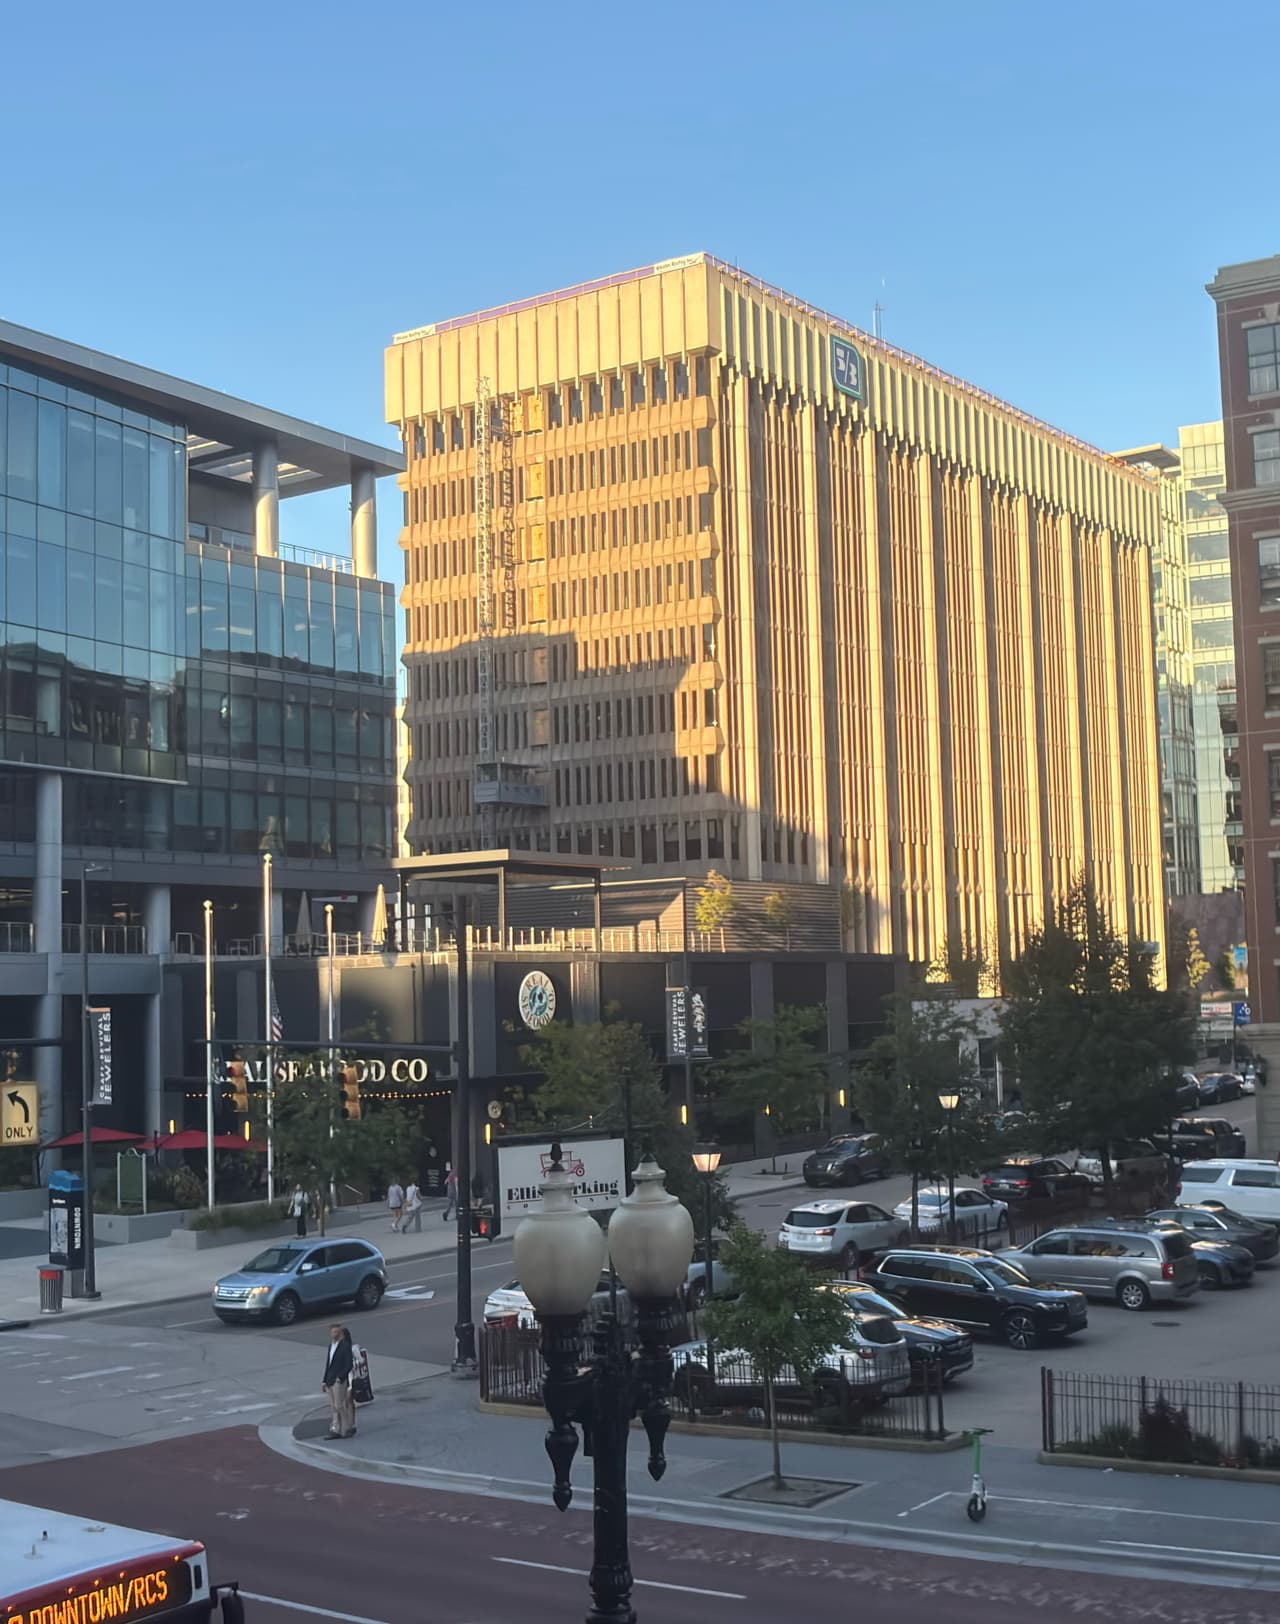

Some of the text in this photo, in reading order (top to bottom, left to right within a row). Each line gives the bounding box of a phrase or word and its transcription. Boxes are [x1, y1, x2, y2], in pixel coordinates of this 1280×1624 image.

[677, 991, 687, 1054] JEWELERS
[102, 1012, 112, 1101] JEWELERS
[390, 1058, 428, 1083] CO
[5, 1127, 34, 1139] ONLY
